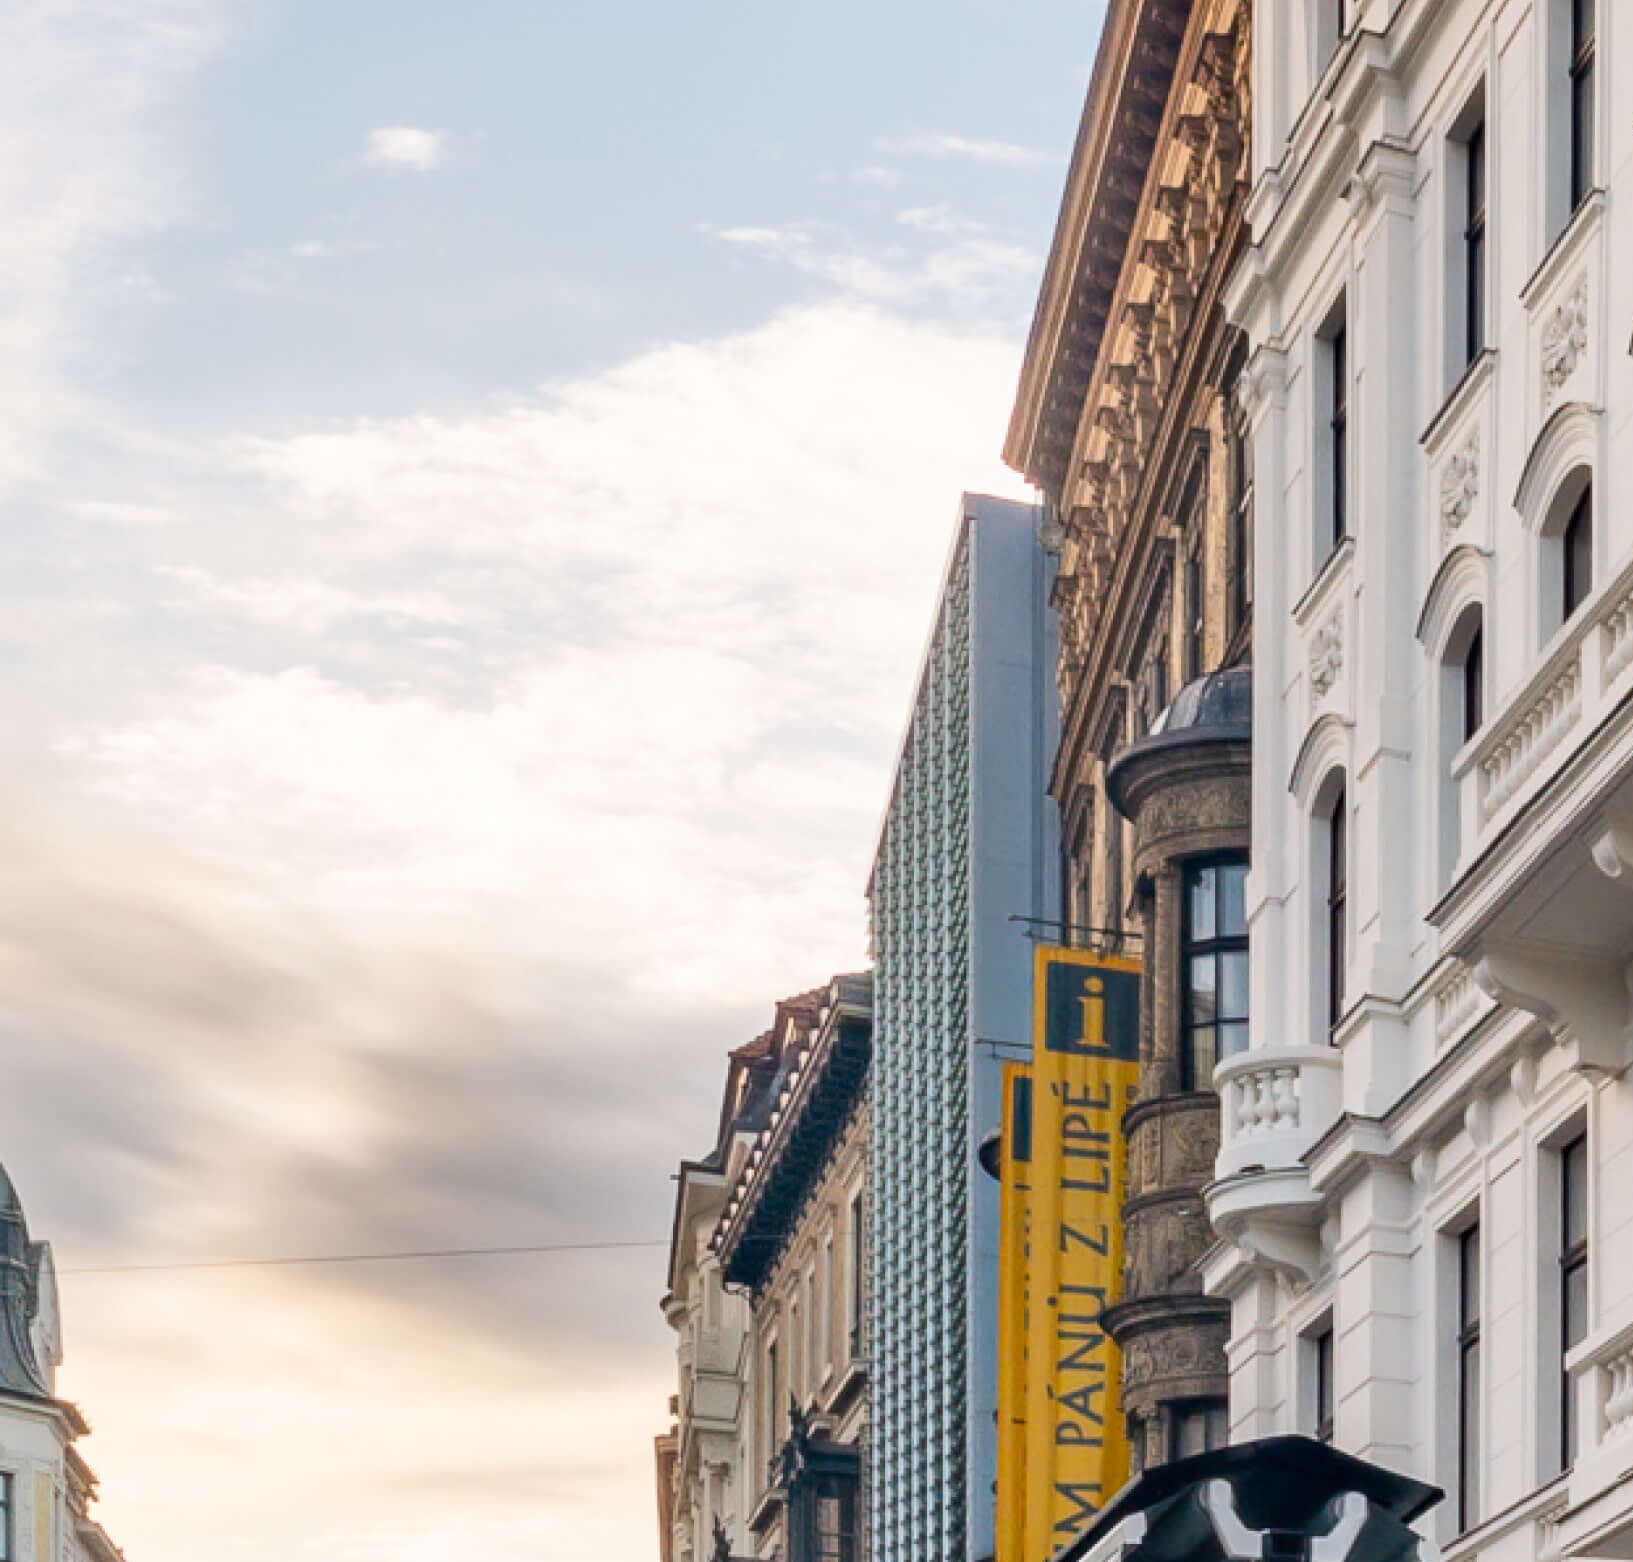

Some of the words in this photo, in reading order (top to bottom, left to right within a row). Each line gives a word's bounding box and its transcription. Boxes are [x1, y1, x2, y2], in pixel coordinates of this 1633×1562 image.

[1050, 1080, 1112, 1194] LIPÉ
[1059, 1222, 1109, 1257] Z
[1047, 1284, 1107, 1448] PÁNŮ
